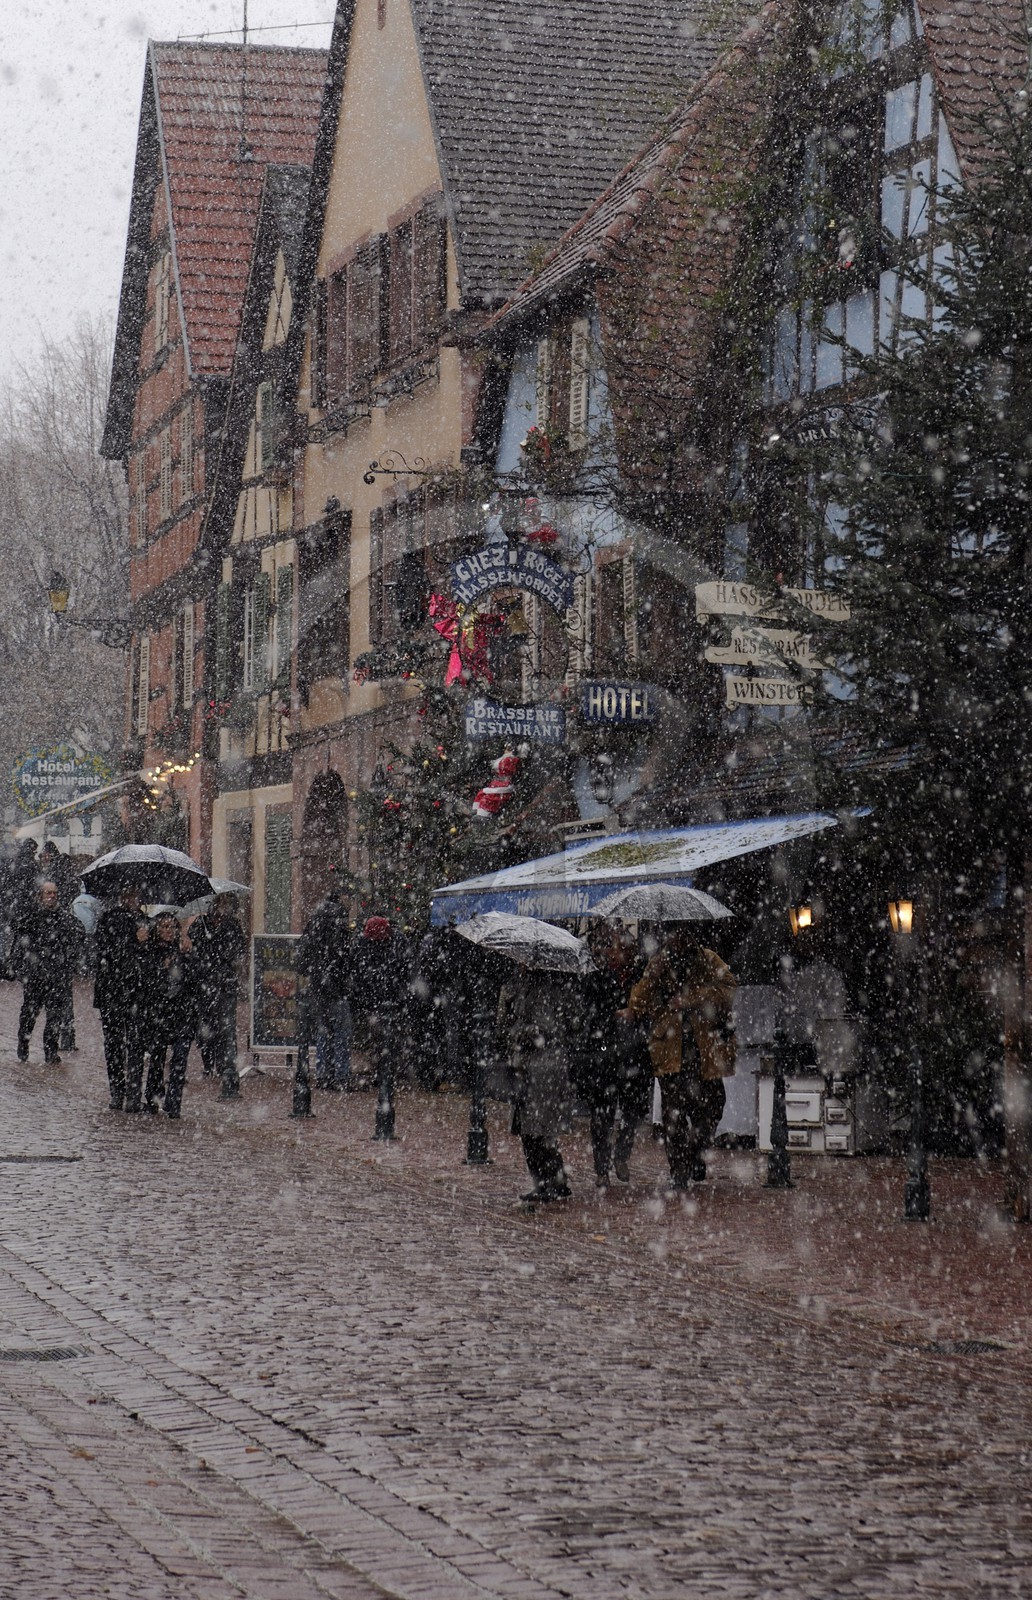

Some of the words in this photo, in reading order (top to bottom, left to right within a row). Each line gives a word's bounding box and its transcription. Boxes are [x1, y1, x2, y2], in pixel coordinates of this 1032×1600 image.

[455, 546, 506, 582] CHEZ
[523, 551, 570, 591] ROGER
[455, 570, 566, 611] HASSENFORDER
[715, 584, 848, 612] HASSRDER
[734, 637, 808, 657] RESRANT
[473, 700, 560, 722] BRASSERIE
[588, 686, 654, 720] HOTEL
[465, 717, 563, 738] RESTAURANT
[21, 773, 101, 786] Restaurant
